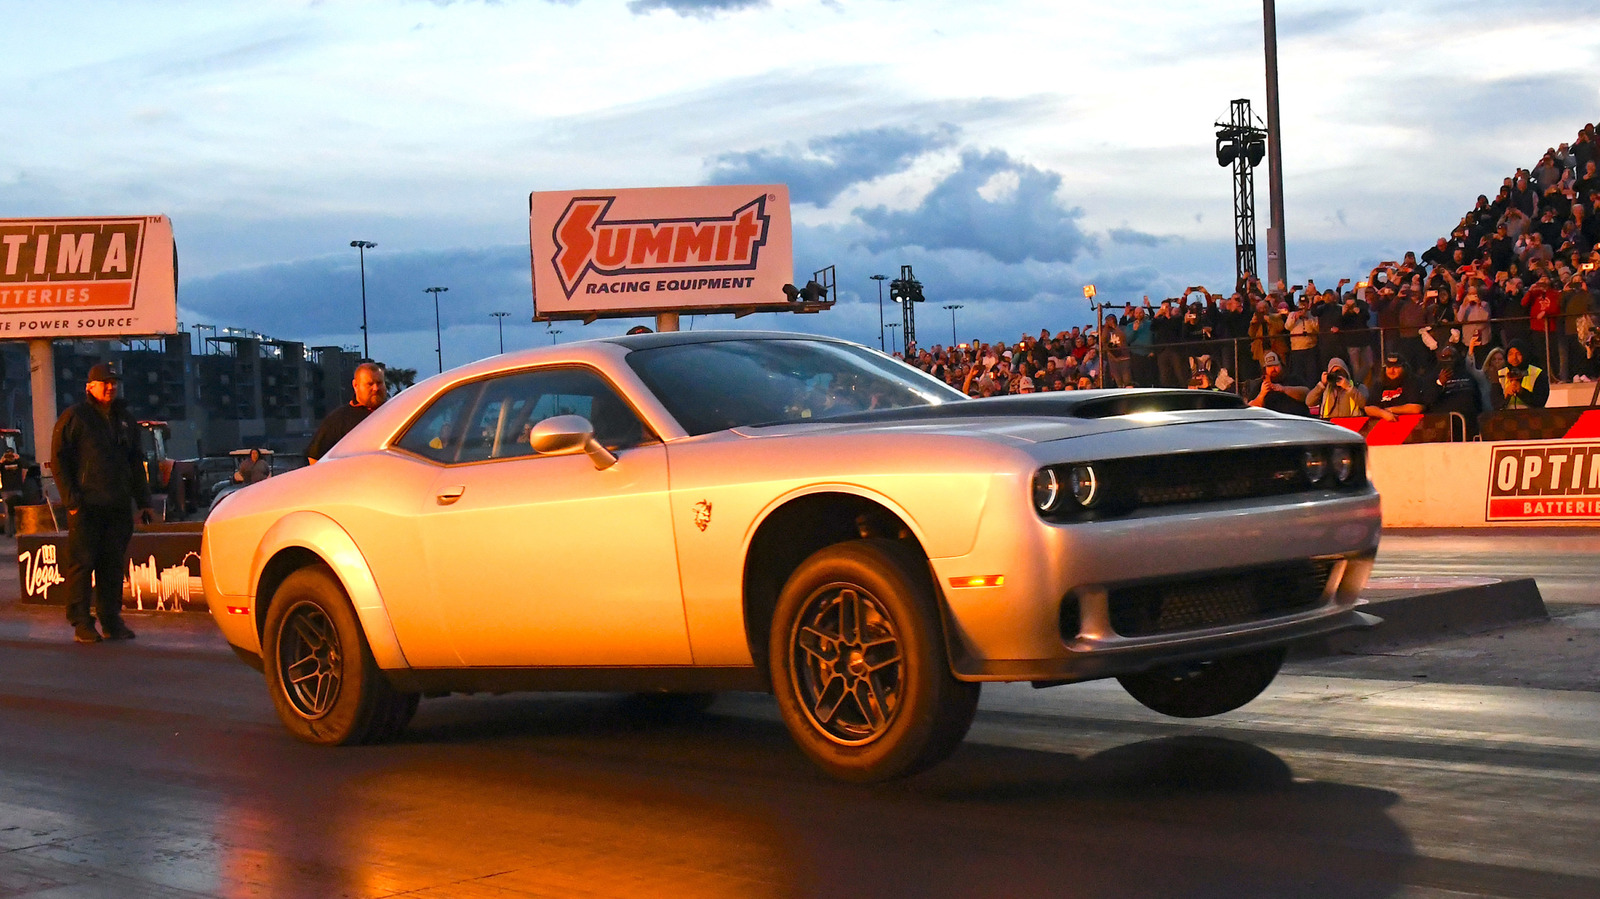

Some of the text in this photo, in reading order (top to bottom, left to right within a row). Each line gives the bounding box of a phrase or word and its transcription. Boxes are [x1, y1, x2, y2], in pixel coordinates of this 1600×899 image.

[586, 277, 755, 294] RACING EQUIPMENT
[19, 319, 69, 330] POWER
[18, 548, 65, 600] Vegas
